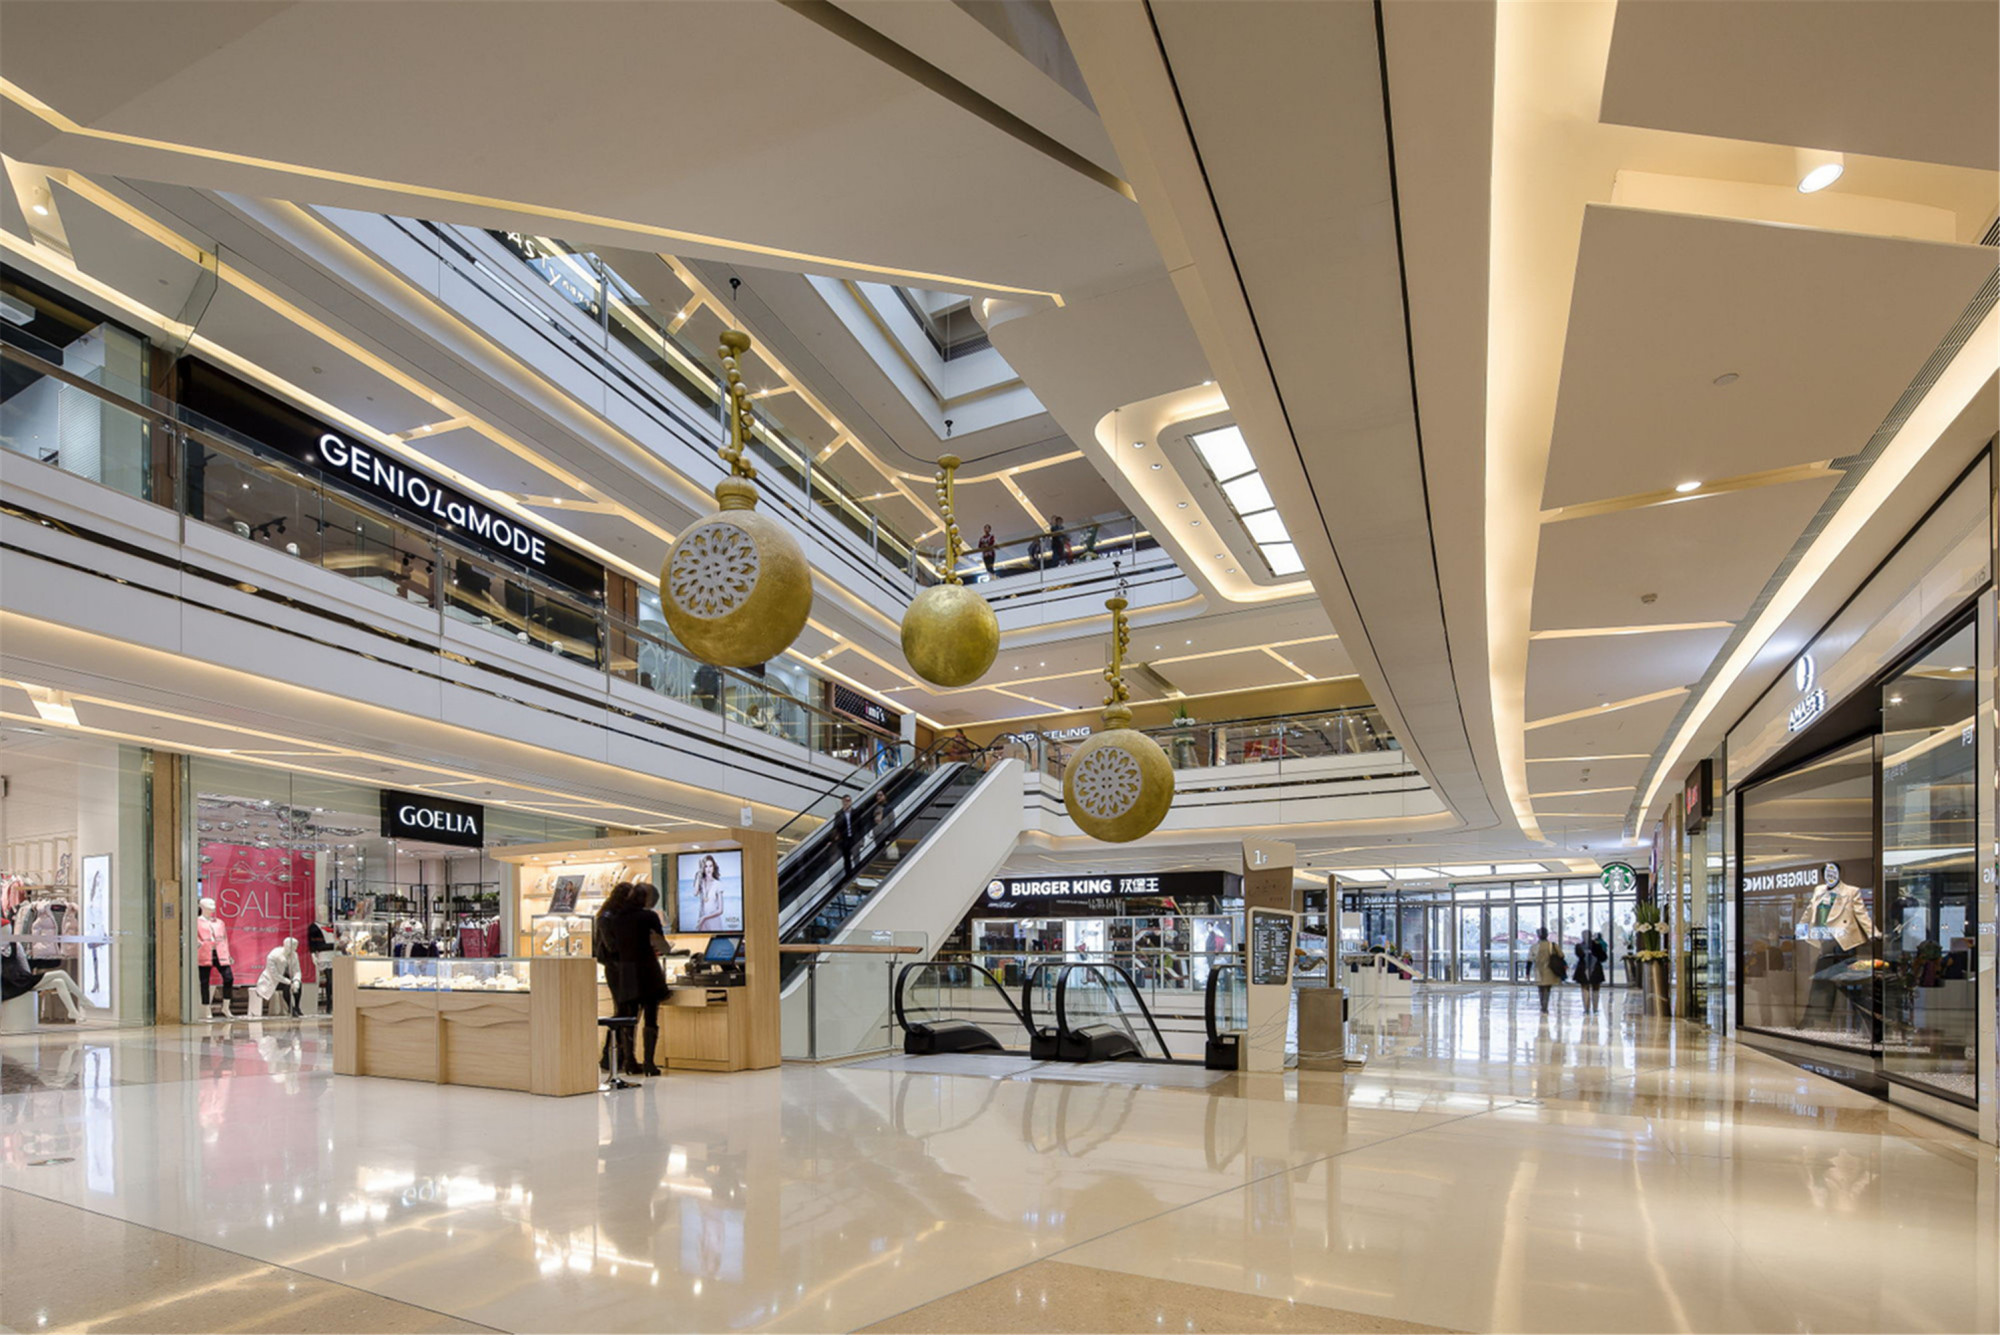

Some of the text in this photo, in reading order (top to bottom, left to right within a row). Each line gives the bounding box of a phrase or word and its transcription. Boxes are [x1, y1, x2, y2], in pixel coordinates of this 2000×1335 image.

[399, 805, 478, 835] GOELIA
[1254, 849, 1268, 865] 1F
[1010, 878, 1113, 896] BURGER KING
[1119, 877, 1160, 894] 汉堡王
[219, 887, 301, 920] SALE
